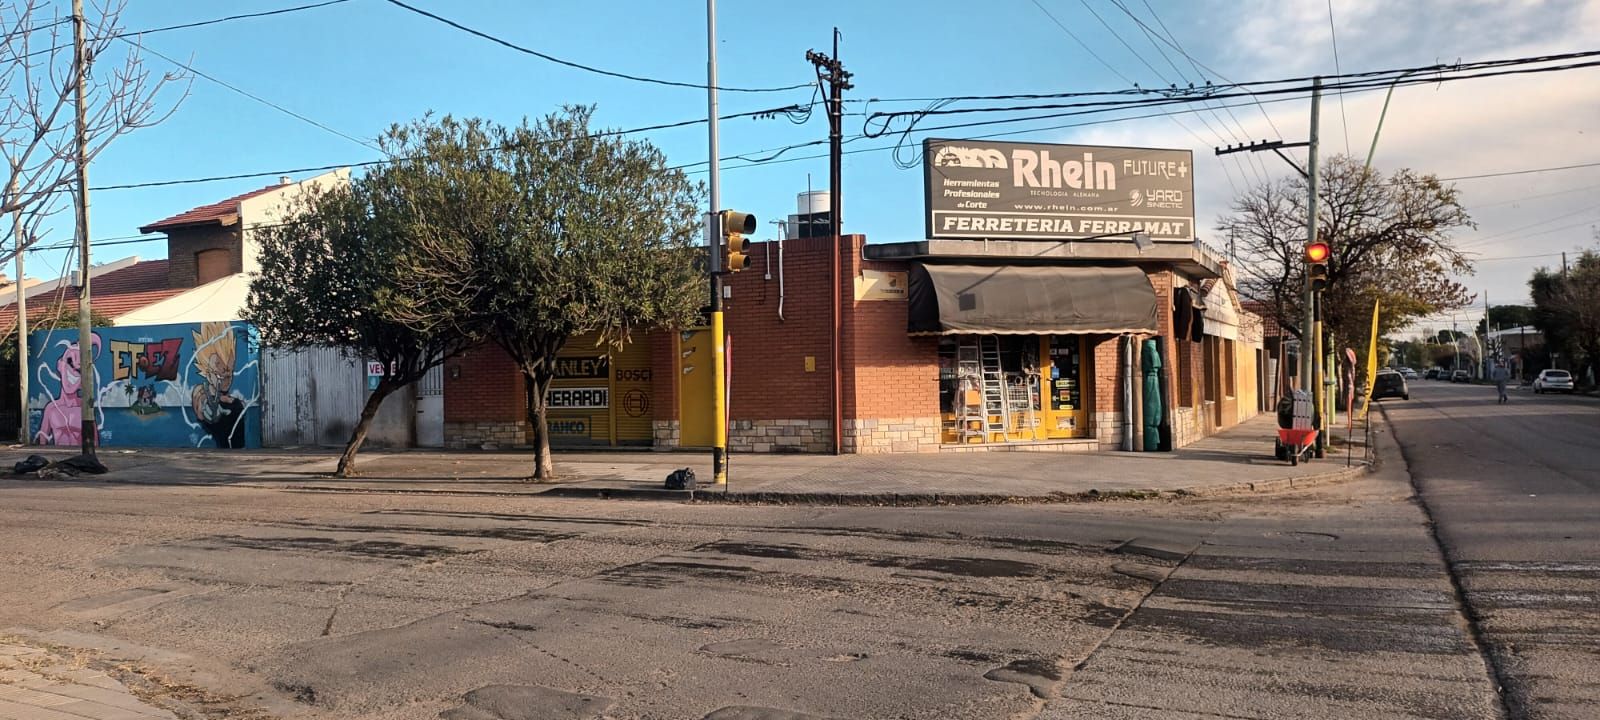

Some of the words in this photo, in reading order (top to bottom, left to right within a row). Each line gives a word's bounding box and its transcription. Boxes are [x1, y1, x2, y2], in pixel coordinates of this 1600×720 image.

[1012, 149, 1116, 190] Rhein
[943, 178, 1000, 188] Herramientas
[943, 189, 1000, 199] Profesionales
[965, 200, 988, 209] Corte
[1014, 204, 1119, 212] www.rhein.com.ar
[943, 216, 1074, 233] FERRETERIA
[1078, 220, 1185, 235] FERRAMAT
